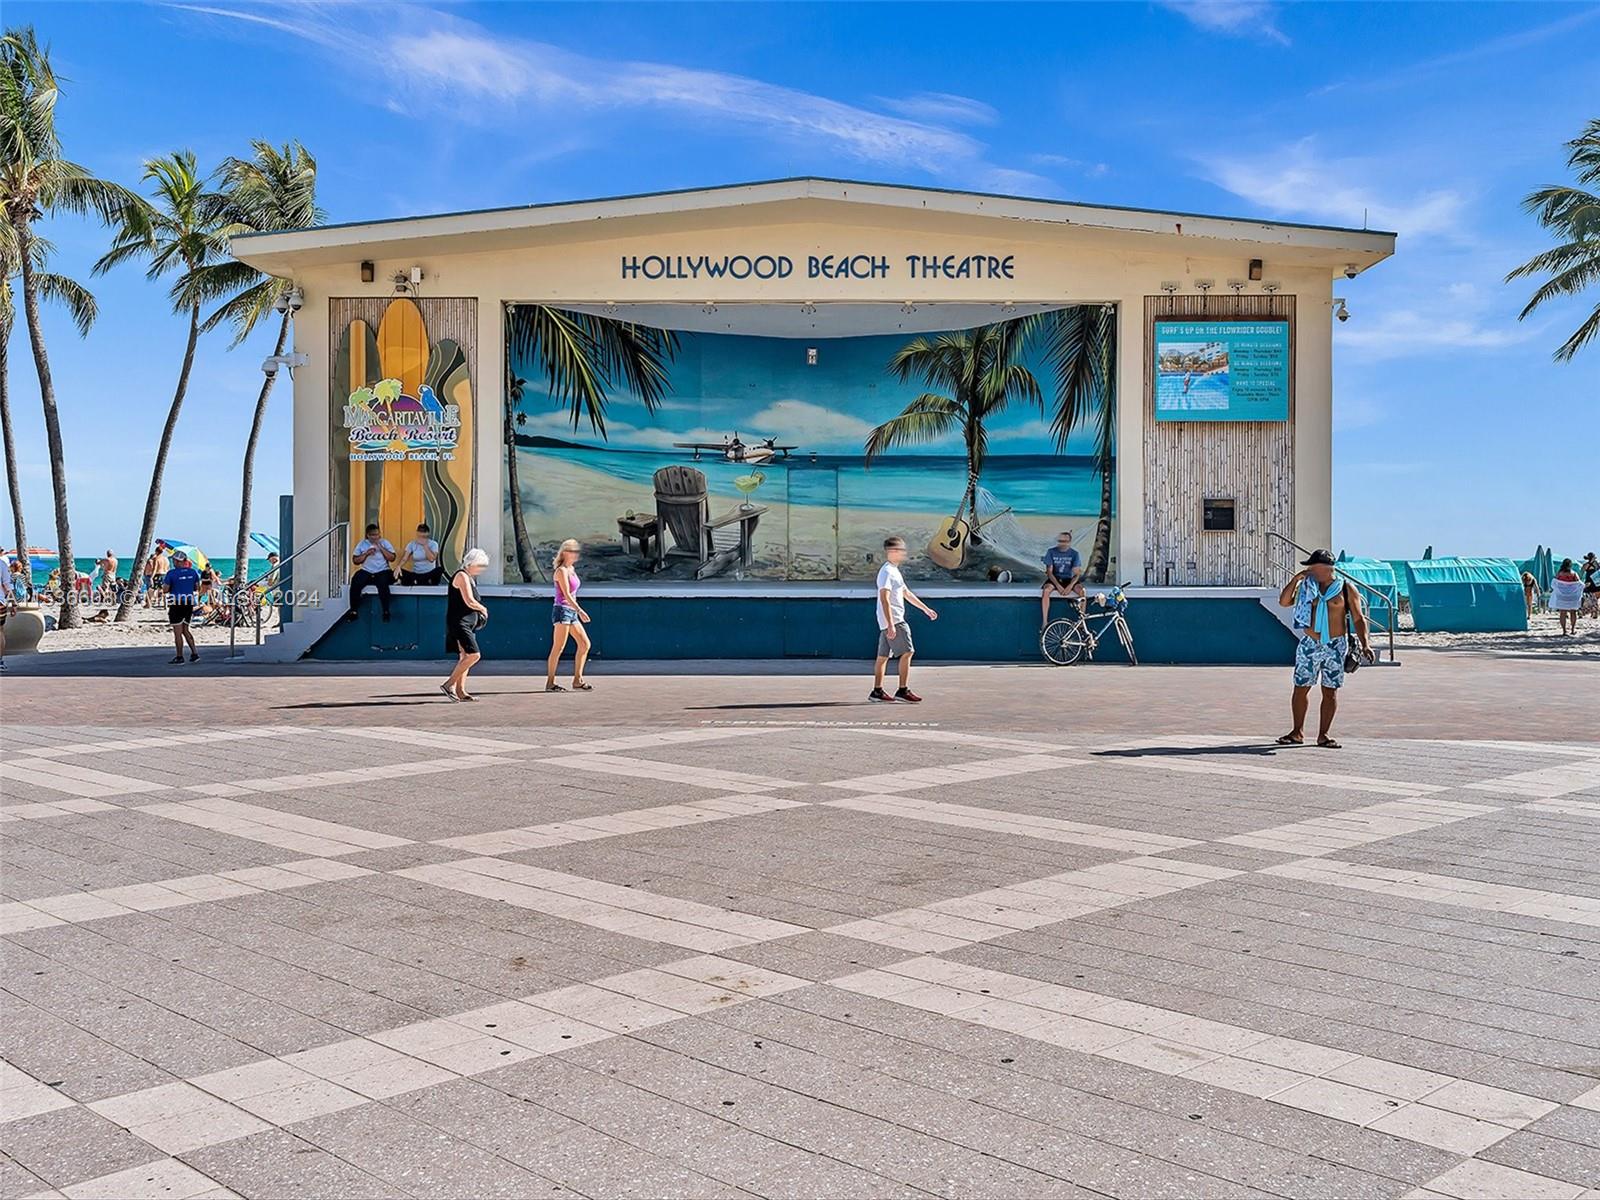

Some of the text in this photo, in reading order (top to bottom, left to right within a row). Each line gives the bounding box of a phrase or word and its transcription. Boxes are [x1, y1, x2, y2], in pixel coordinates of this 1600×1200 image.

[621, 255, 1015, 279] HOLLYWOOD BEACH THEATRE
[343, 405, 461, 428] MARGARITAVILLE
[349, 427, 456, 442] Beach Resort
